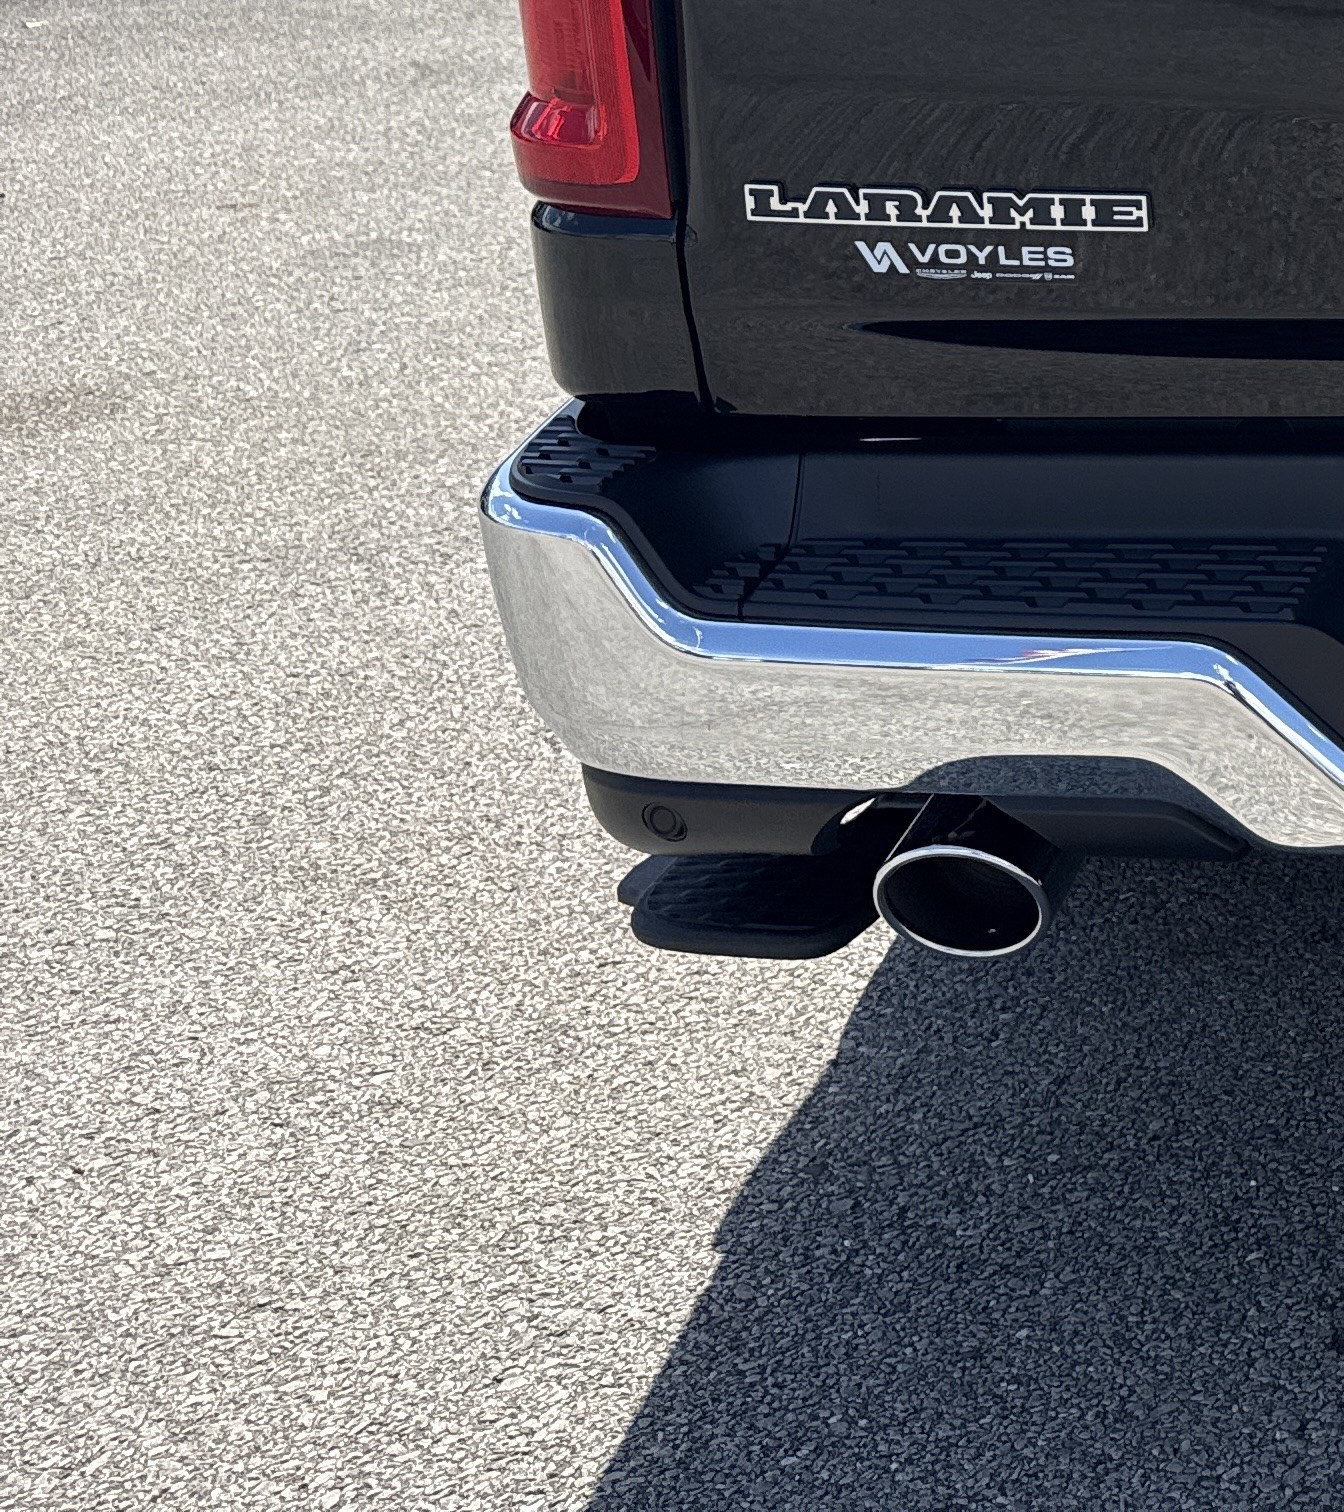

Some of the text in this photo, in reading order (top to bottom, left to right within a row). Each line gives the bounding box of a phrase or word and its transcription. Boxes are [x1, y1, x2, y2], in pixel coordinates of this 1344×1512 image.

[744, 183, 1150, 233] LARAMIE
[907, 242, 1075, 267] VOYLES
[970, 270, 993, 280] Jeep
